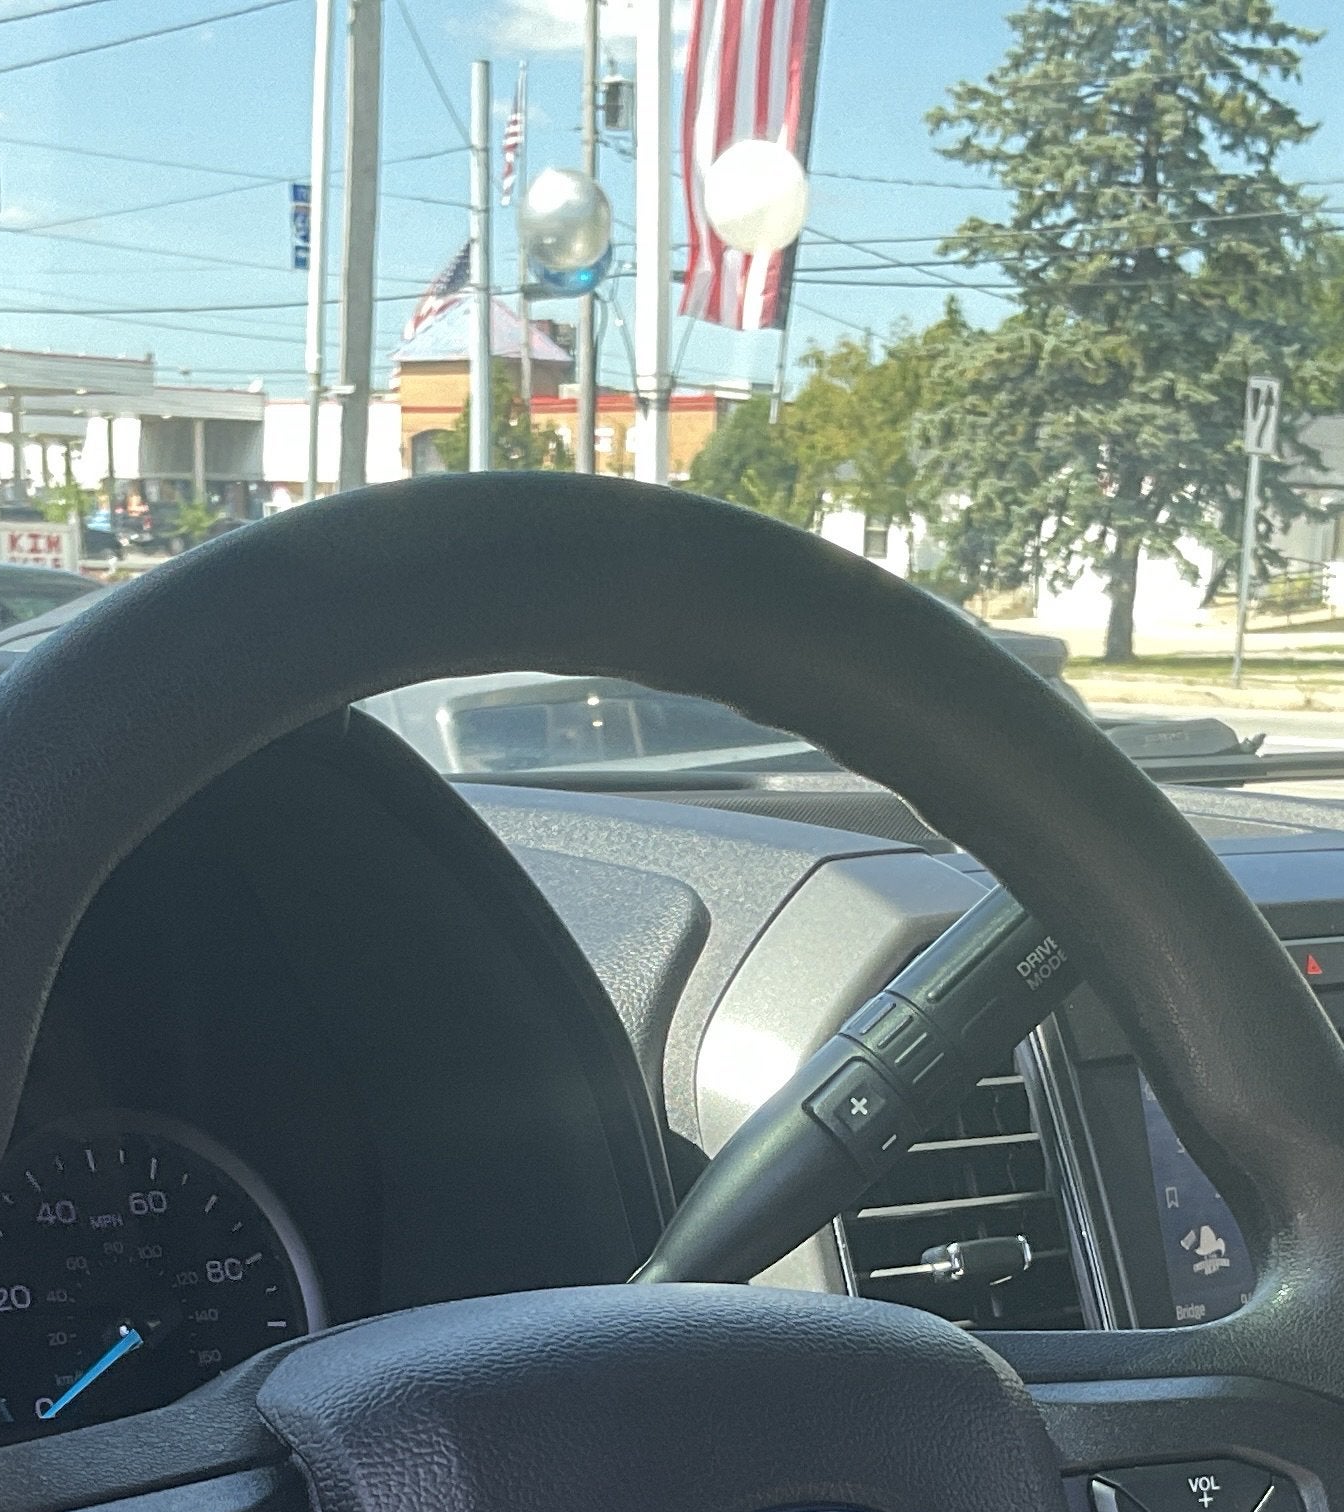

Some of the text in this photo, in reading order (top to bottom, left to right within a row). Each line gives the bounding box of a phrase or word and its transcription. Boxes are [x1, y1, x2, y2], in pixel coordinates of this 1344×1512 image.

[1016, 936, 1058, 977] DRIVE
[1025, 949, 1068, 991] MODE
[36, 1200, 77, 1225] 40
[129, 1190, 168, 1216] 60
[205, 1257, 244, 1284] 80
[1175, 1302, 1206, 1321] Bridge
[1188, 1475, 1221, 1493] VOL
